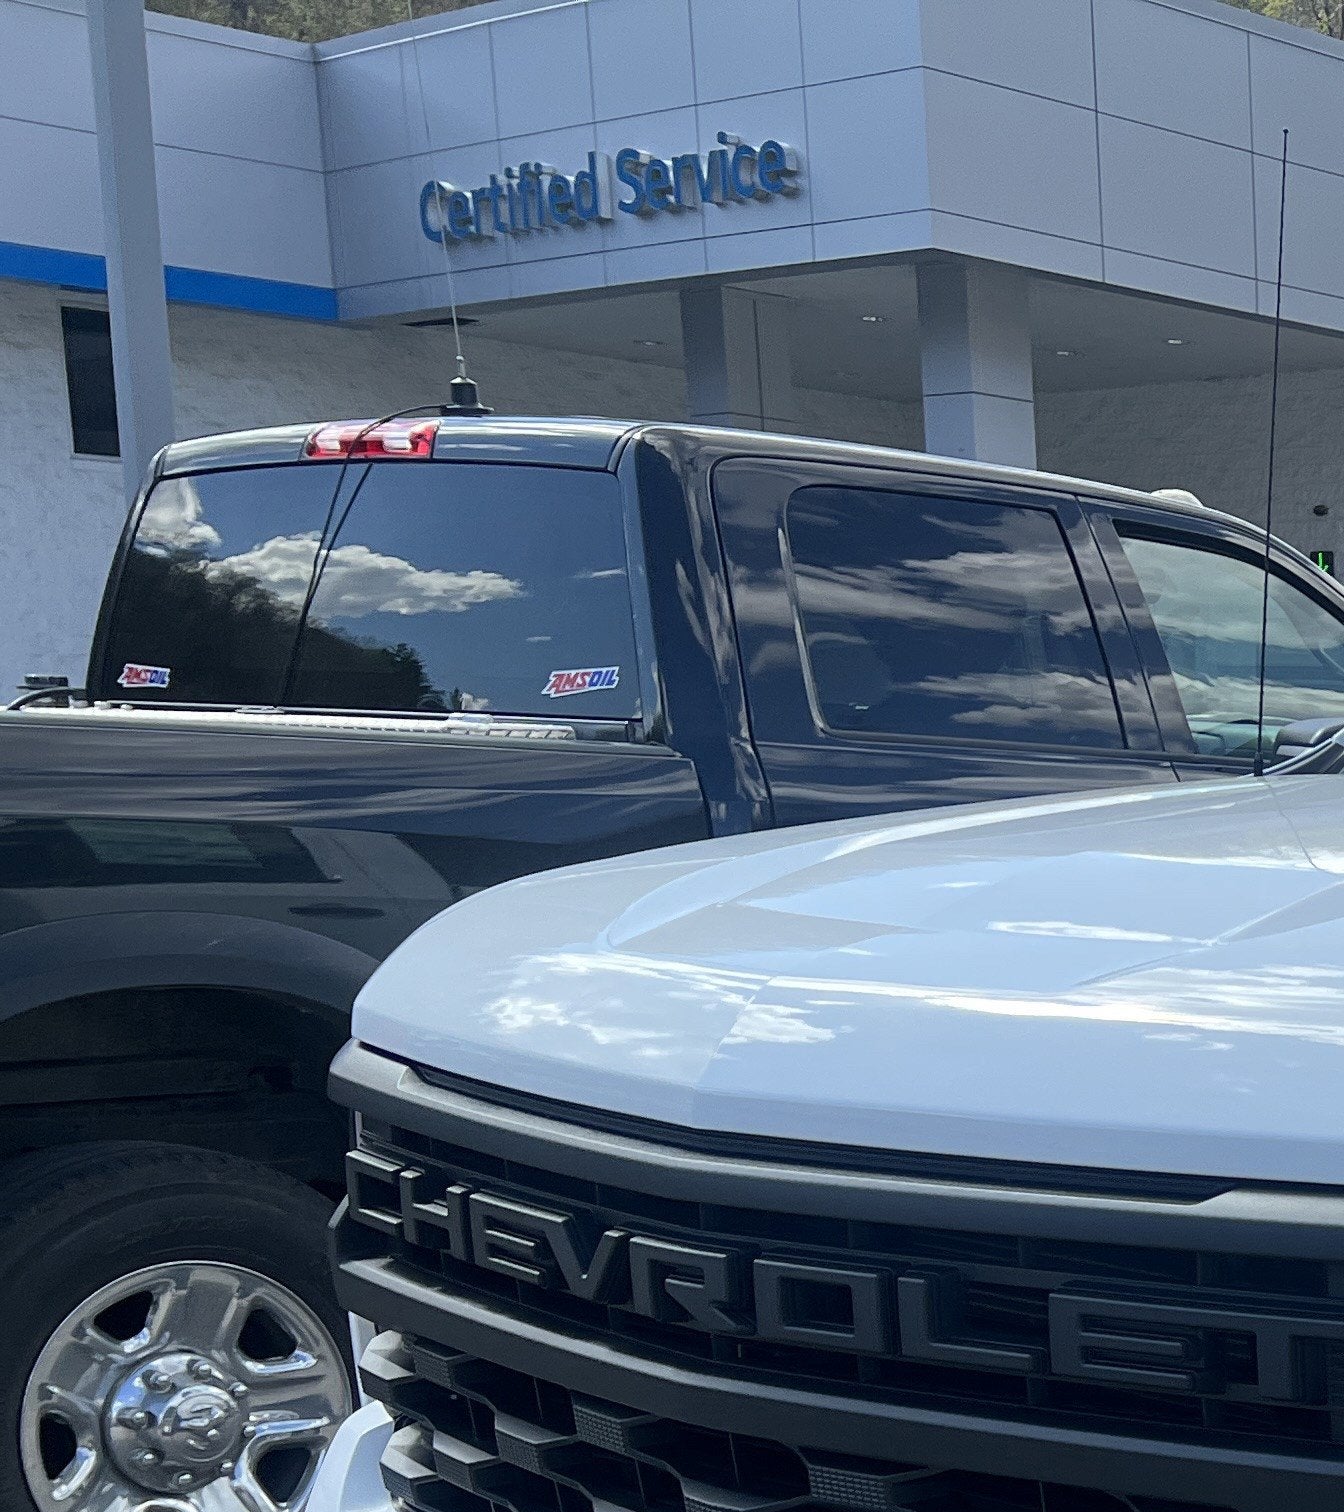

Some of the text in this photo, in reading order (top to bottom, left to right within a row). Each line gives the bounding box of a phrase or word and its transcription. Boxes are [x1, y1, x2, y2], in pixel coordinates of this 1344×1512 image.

[420, 131, 787, 244] Certified Service
[547, 670, 616, 693] AMSOIL
